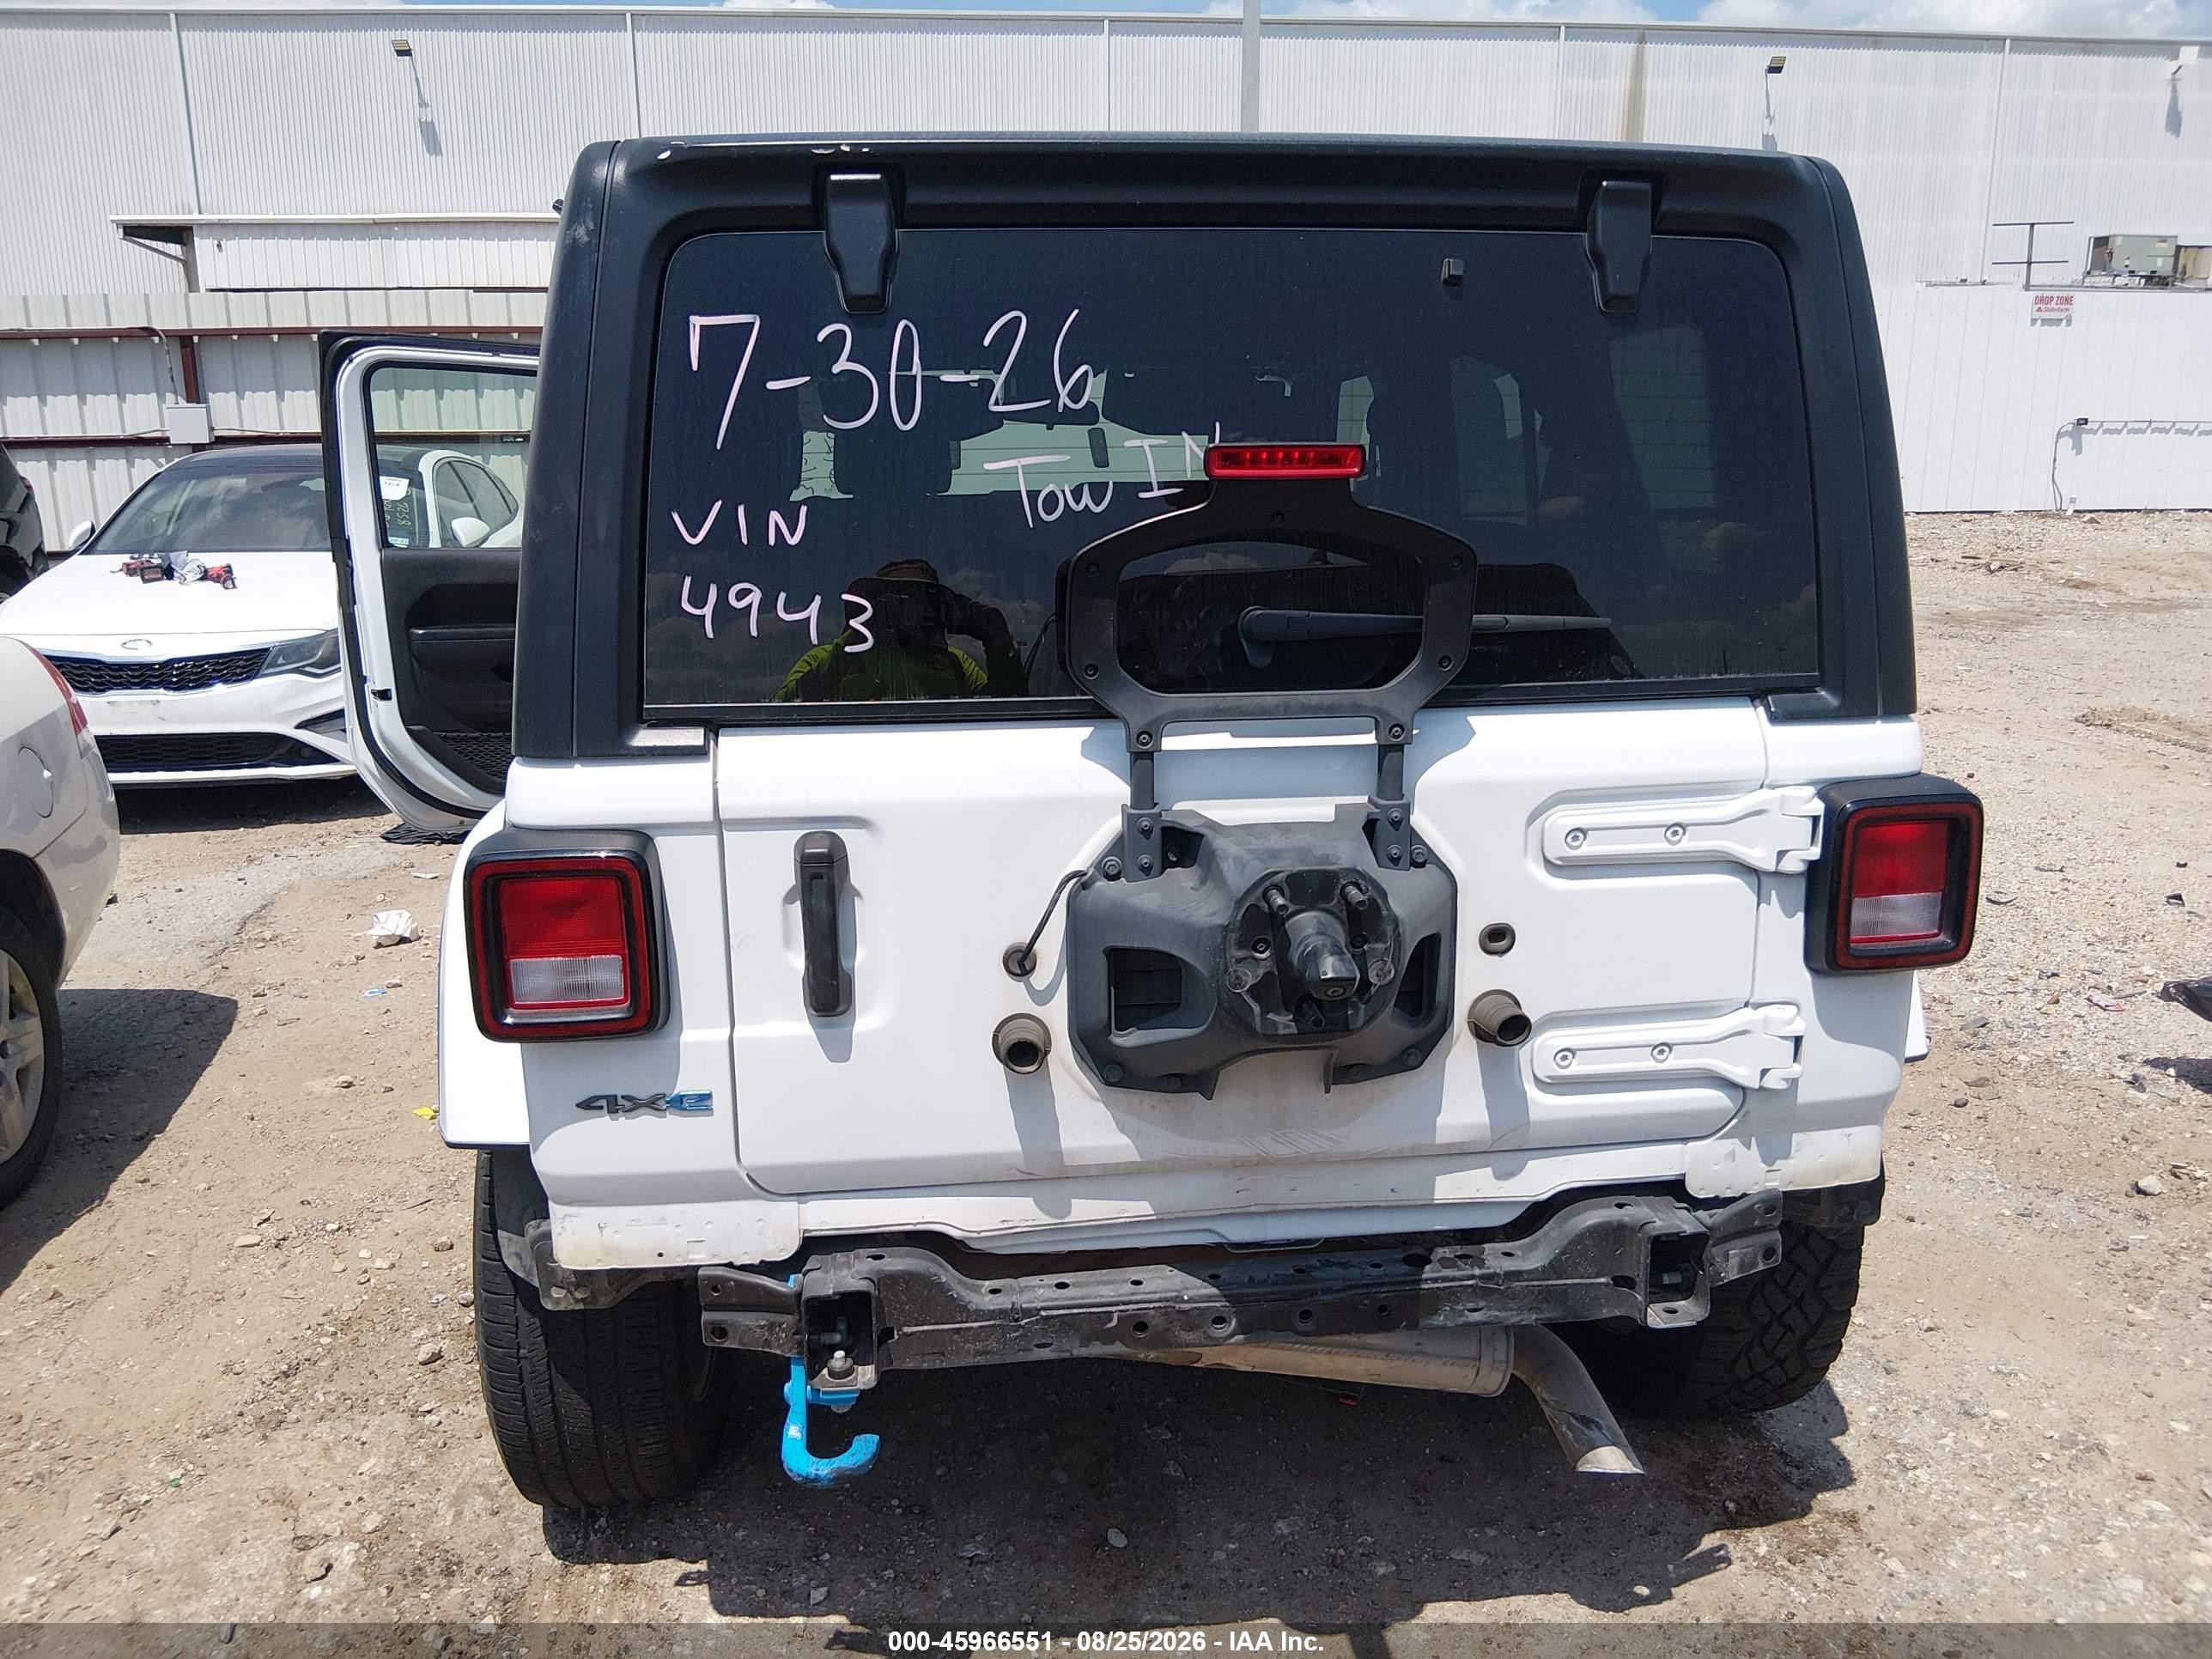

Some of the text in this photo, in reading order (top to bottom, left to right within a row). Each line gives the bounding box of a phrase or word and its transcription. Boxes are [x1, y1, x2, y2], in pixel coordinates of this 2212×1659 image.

[2034, 295, 2074, 306] DROP ZONE
[689, 308, 1094, 450] 7-30-26
[672, 498, 808, 546] VIN
[680, 574, 875, 653] 4943
